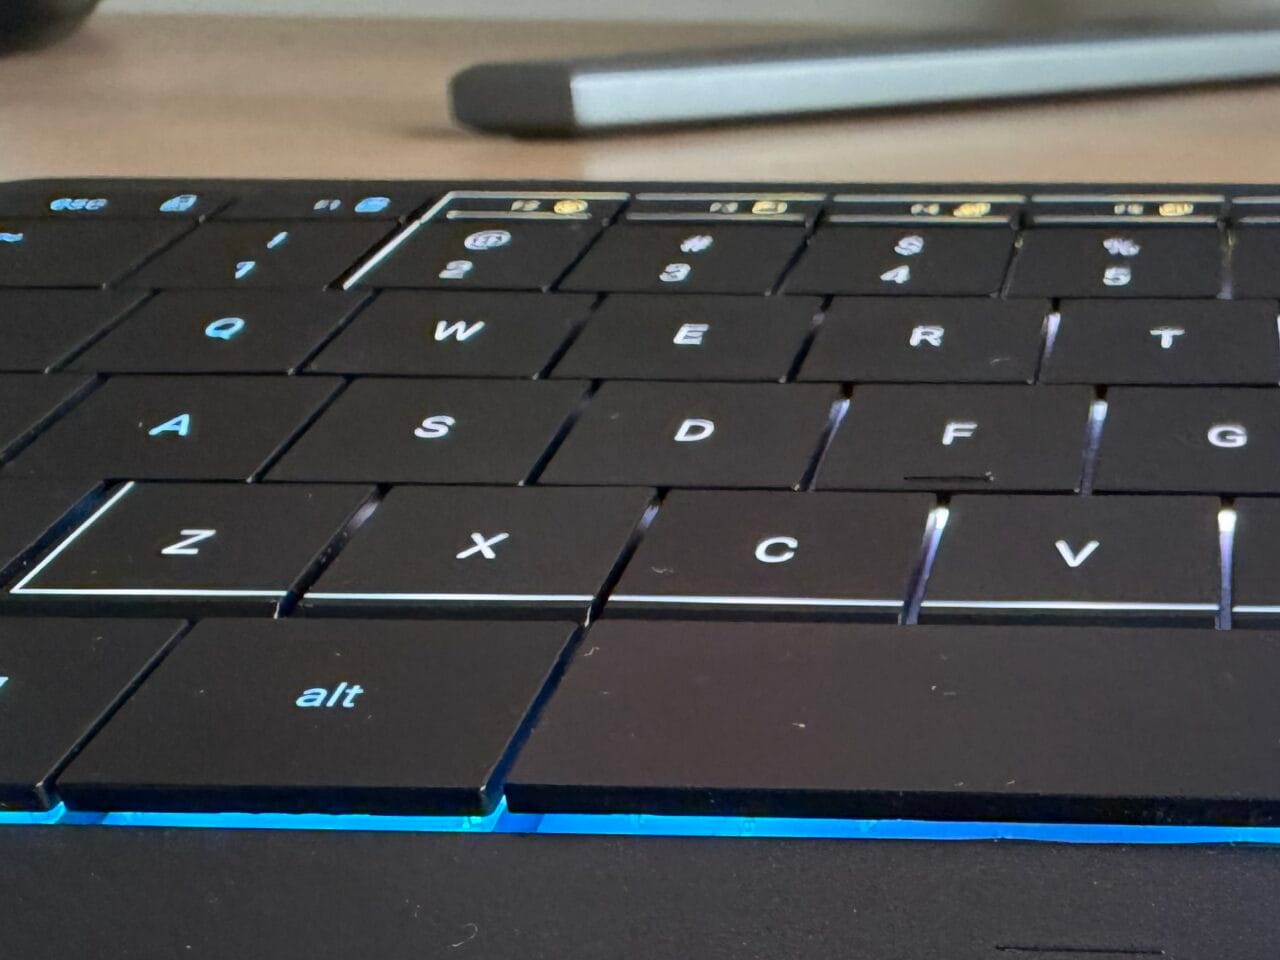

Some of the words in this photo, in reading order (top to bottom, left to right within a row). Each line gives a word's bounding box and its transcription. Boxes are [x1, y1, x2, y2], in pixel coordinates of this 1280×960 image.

[438, 260, 473, 279] 2
[880, 265, 910, 284] 4
[1102, 267, 1131, 286] 5
[204, 317, 245, 340] Q
[434, 320, 485, 342] W
[672, 323, 709, 345] E
[909, 325, 945, 347] R
[1149, 327, 1185, 349] T
[148, 413, 191, 437] A
[414, 415, 456, 439] S
[674, 418, 715, 442] D
[942, 421, 978, 446] F
[1207, 424, 1248, 448] G
[161, 529, 217, 555] Z
[455, 532, 510, 560] X
[754, 536, 798, 563] C
[1055, 540, 1100, 568] V
[295, 681, 364, 708] alt
